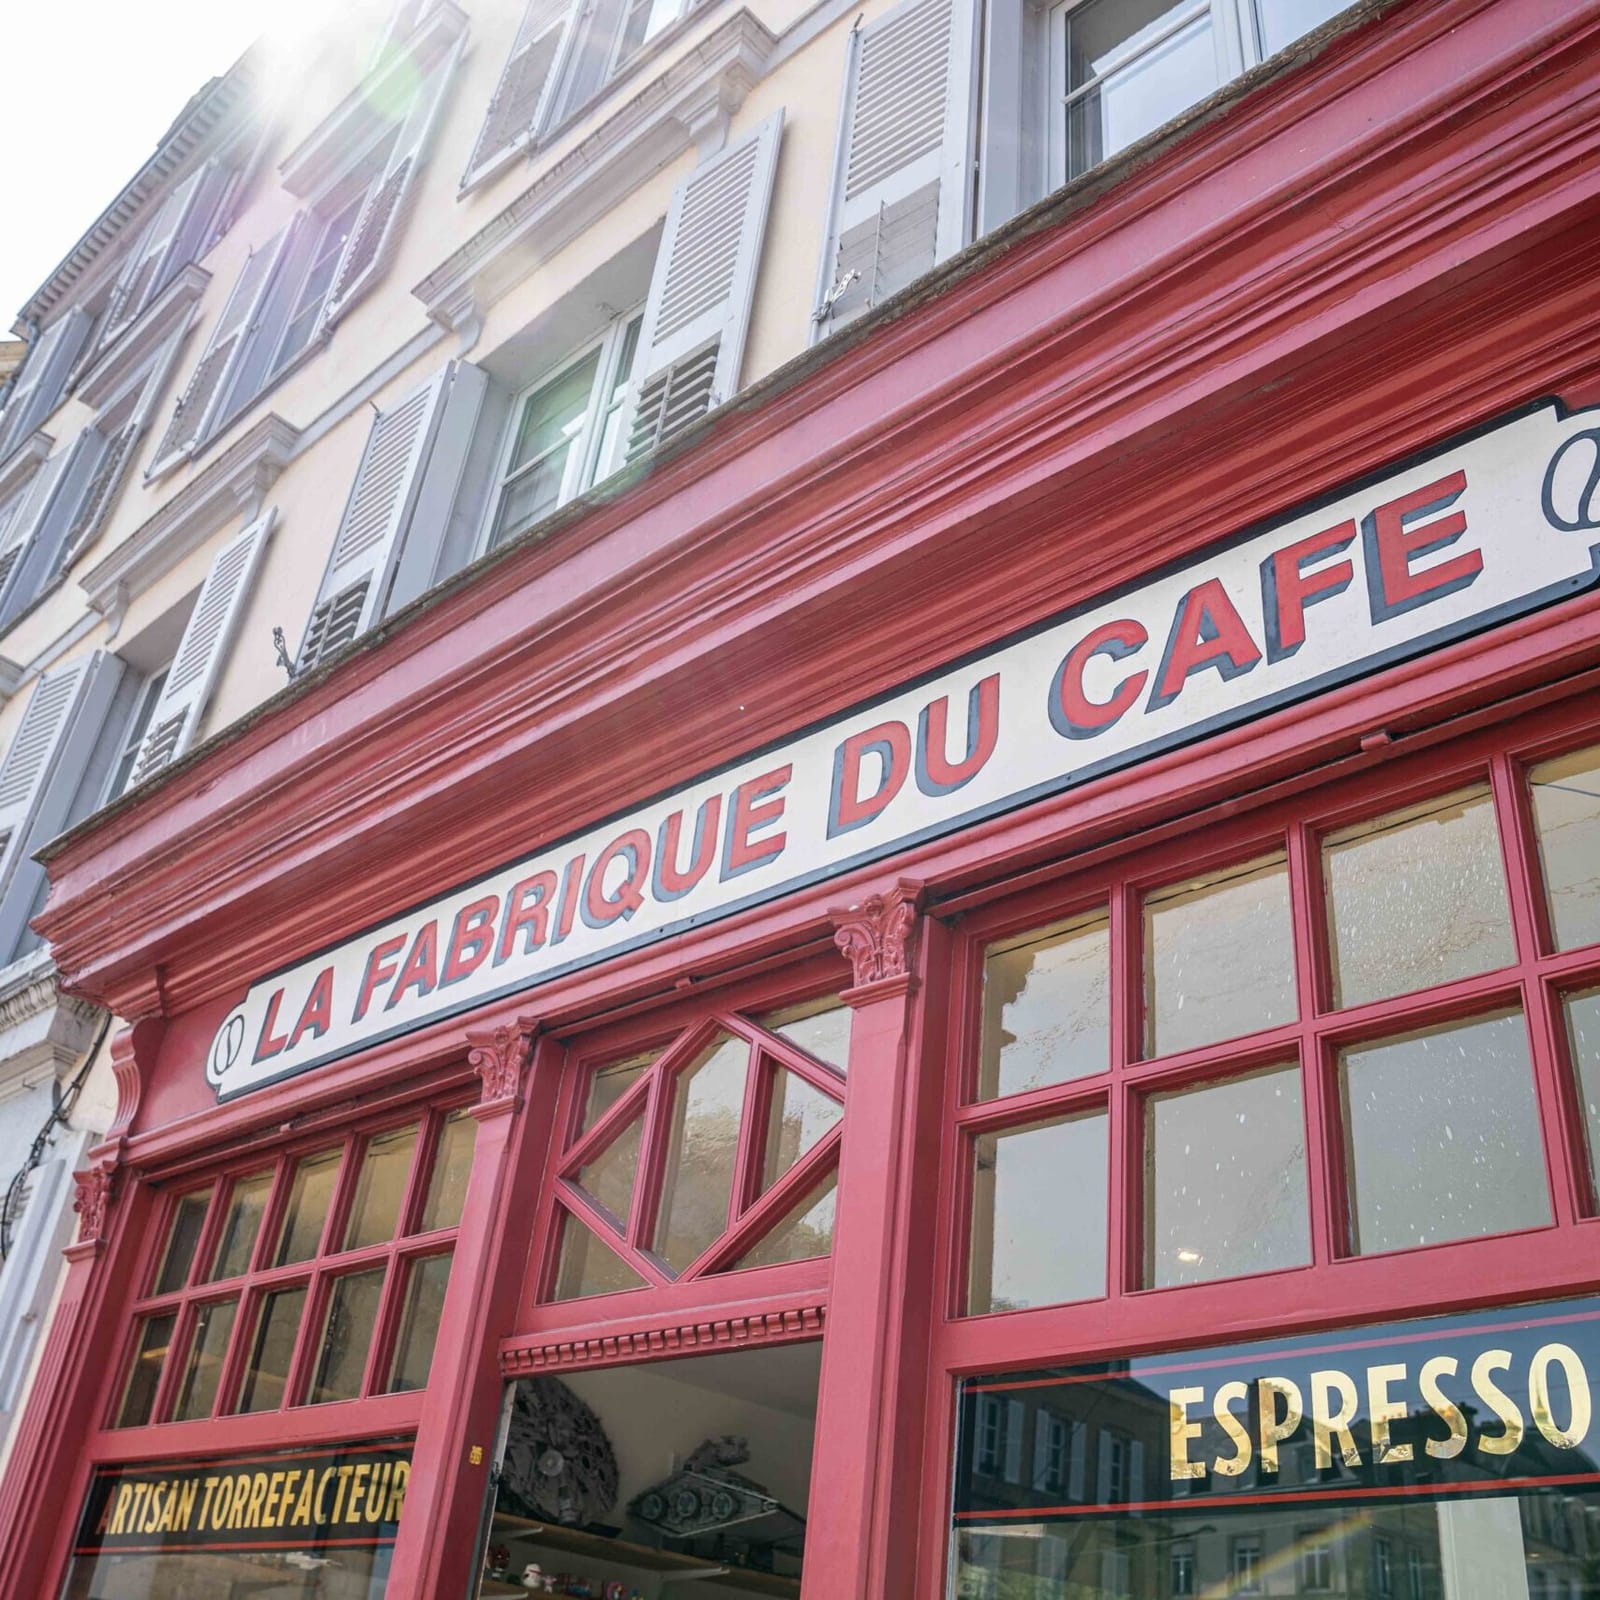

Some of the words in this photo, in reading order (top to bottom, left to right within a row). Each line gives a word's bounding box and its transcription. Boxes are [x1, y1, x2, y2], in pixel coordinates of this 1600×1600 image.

[252, 967, 334, 1065] LA
[351, 763, 792, 1025] FABRIQUE
[827, 673, 1000, 839] DU
[1048, 469, 1484, 740] CAFE
[1169, 1343, 1592, 1480] ESPRESSO
[96, 1478, 198, 1534] ARTISAN
[197, 1461, 411, 1530] TORREFACTEUR
